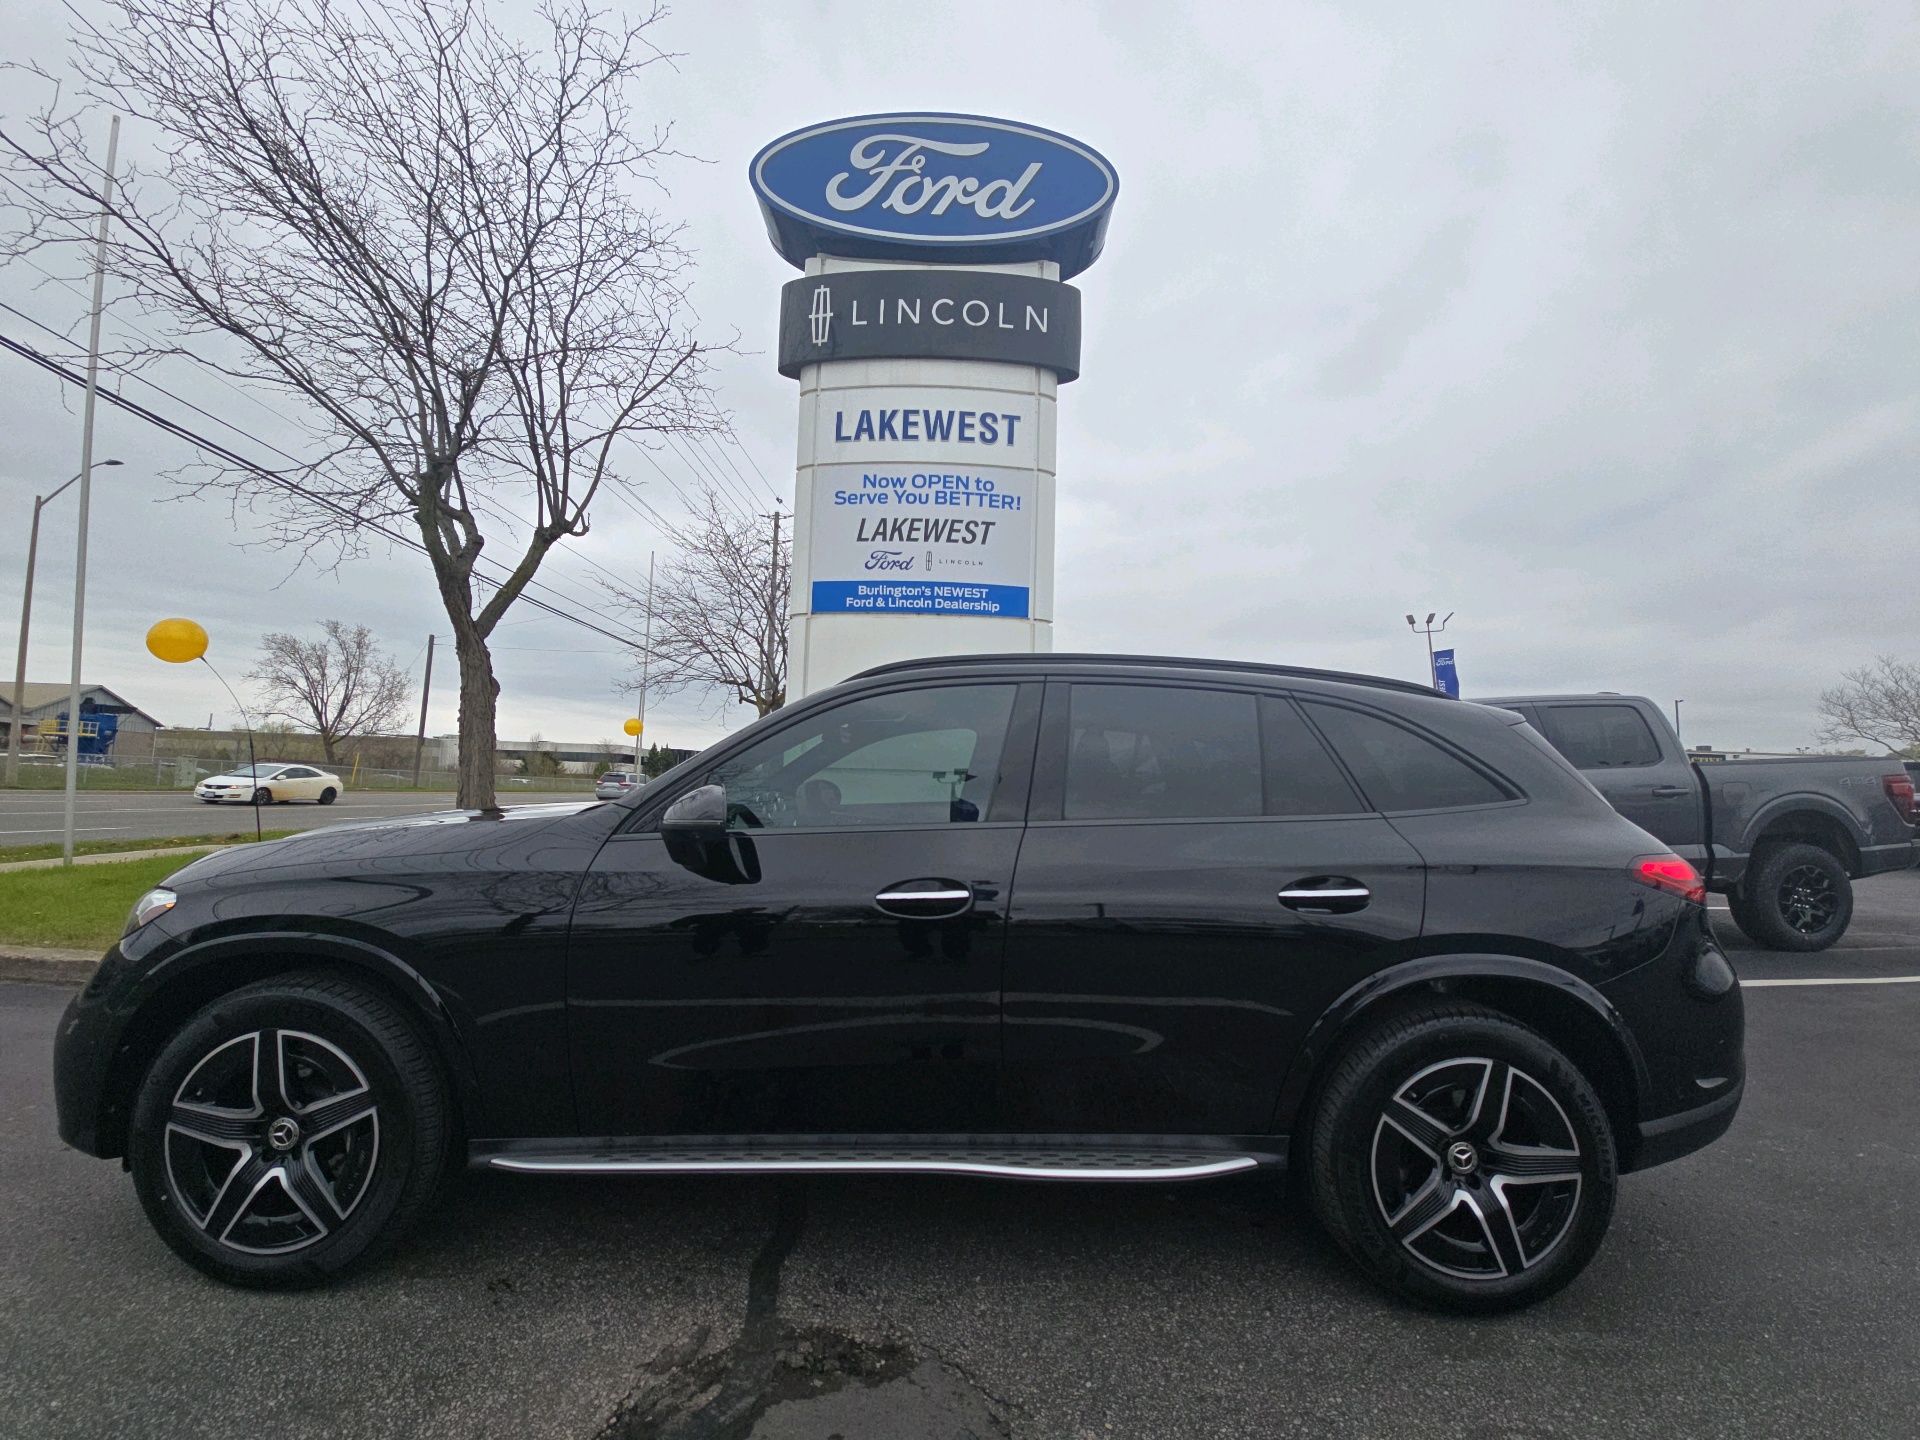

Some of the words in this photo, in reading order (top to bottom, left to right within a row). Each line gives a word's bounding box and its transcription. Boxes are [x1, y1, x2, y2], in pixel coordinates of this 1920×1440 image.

[825, 134, 1044, 220] Ford
[852, 297, 1049, 333] LINCOLN
[835, 409, 1021, 446] LAKEWEST
[863, 474, 907, 489] Now
[911, 474, 970, 490] OPEN
[975, 477, 995, 492] to
[834, 491, 889, 505] Serve
[893, 490, 929, 505] You
[935, 491, 1021, 510] BETTER!
[856, 517, 996, 545] LAKEWEST
[864, 550, 915, 571] Ford
[938, 558, 984, 566] LINCOLN
[857, 585, 932, 597] Burlington's
[934, 586, 989, 599] NEWEST
[846, 598, 874, 608] Ford
[876, 598, 885, 608] &
[888, 598, 932, 609] Lincoln
[935, 599, 1000, 613] Dealership
[1436, 657, 1454, 666] Ford
